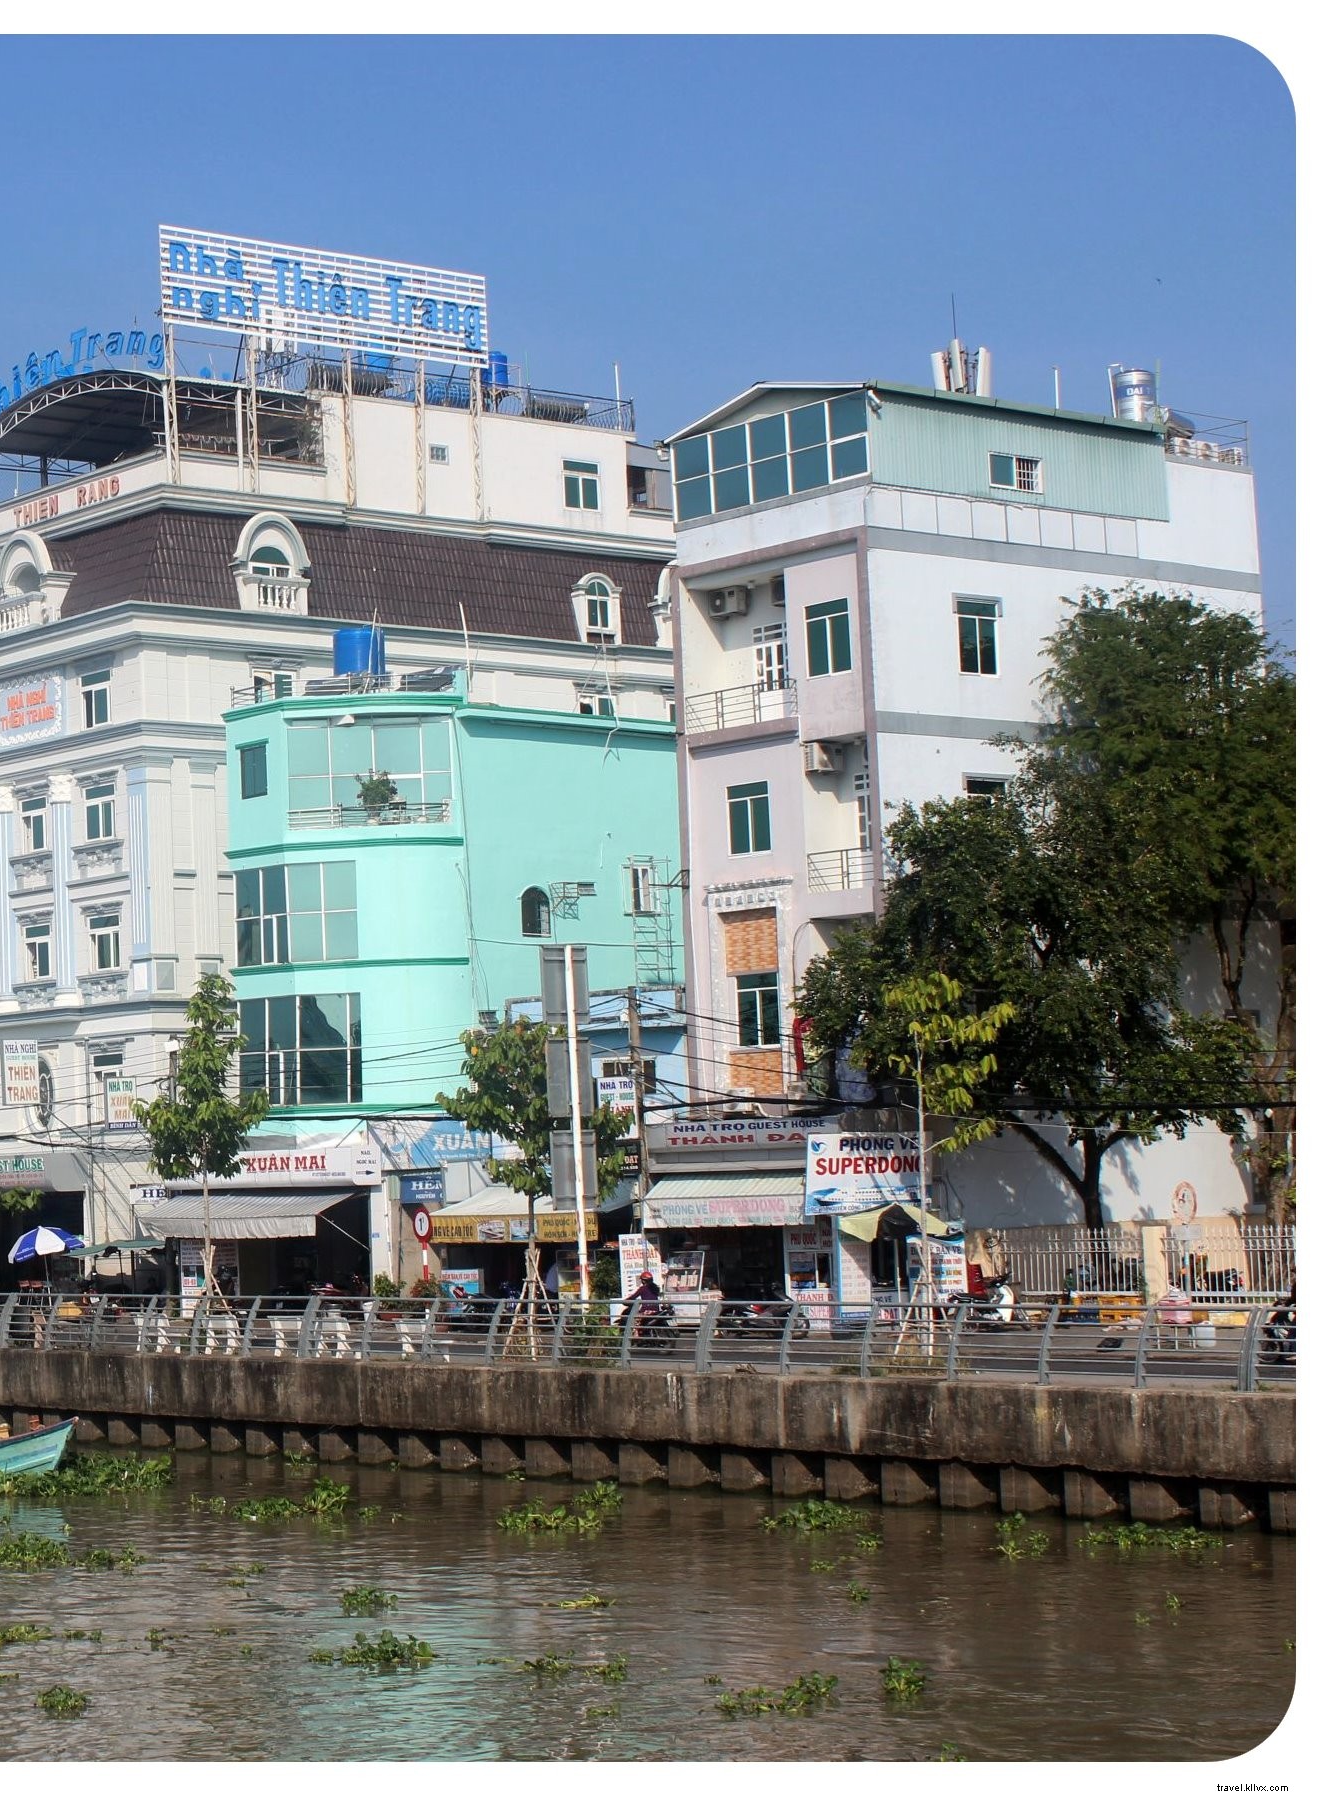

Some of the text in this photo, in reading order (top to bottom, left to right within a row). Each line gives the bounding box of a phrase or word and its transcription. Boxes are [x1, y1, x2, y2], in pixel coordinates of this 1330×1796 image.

[172, 281, 262, 321] nghỉ
[272, 258, 482, 352] Thiên Trang
[70, 326, 166, 370] Trang
[14, 476, 121, 528] THIEN RANG
[5, 1042, 19, 1054] NHÀ
[8, 1062, 36, 1081] THIÊN
[7, 1086, 38, 1101] TRANG
[748, 1121, 787, 1130] GUEST
[792, 1118, 826, 1128] HOUSE
[667, 1132, 808, 1146] THÀNH ĐẠ
[12, 1157, 45, 1171] HOUSE
[247, 1152, 327, 1173] XUÂN MAI
